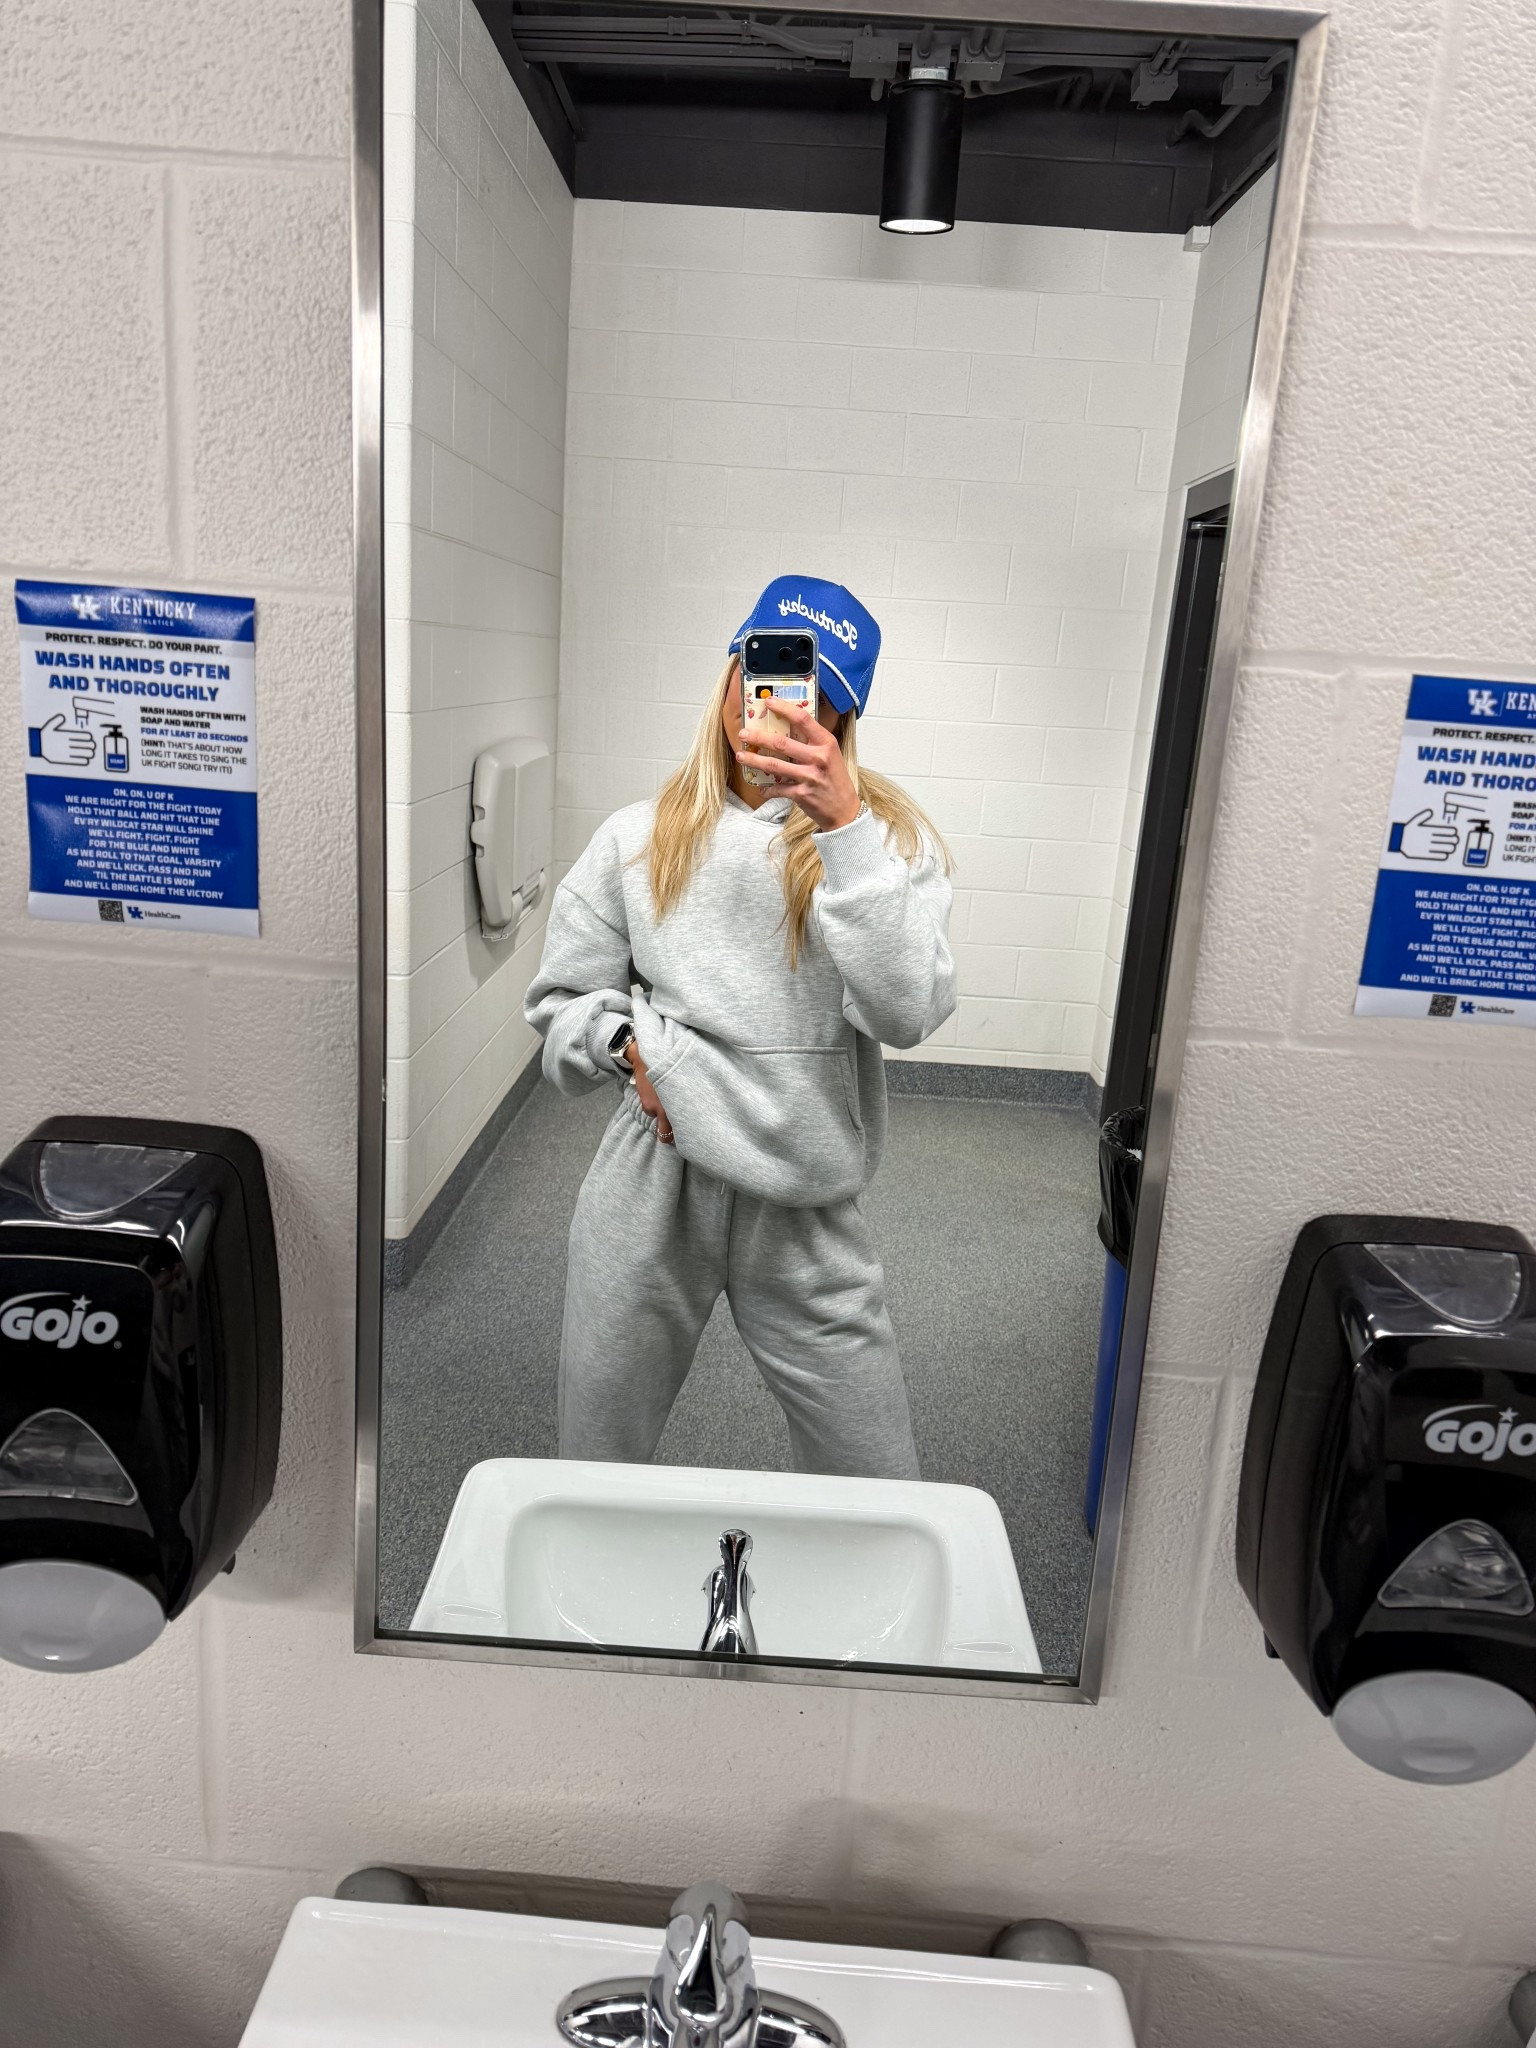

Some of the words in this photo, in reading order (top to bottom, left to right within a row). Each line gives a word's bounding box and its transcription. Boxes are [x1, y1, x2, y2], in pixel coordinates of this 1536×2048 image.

[110, 596, 195, 620] KENTUCKY
[45, 632, 95, 644] PROTECT.
[98, 636, 146, 648] RESPECT.
[149, 640, 162, 650] DO
[165, 641, 191, 652] YOUR
[194, 643, 221, 654] PART.
[35, 650, 94, 669] WASH
[99, 655, 164, 675] HANDS
[170, 660, 229, 680] OFTEN
[48, 673, 88, 691] AND
[94, 677, 218, 702] THOROUGHLY
[140, 706, 164, 715] WASH
[166, 708, 193, 717] HANDS
[195, 710, 221, 719] OFTEN
[223, 712, 245, 721] WITH
[140, 716, 162, 725] SOAP
[164, 718, 180, 726] AND
[182, 720, 210, 728] WATER
[140, 727, 157, 735] FOR
[170, 729, 194, 738] LEAST
[209, 733, 247, 742] SECONDS
[1432, 727, 1483, 739] PROTECT.
[1484, 731, 1536, 743] RESPECT.
[194, 743, 220, 752] ABOUT
[223, 745, 241, 754] HOW
[141, 749, 161, 758] LONG
[173, 752, 197, 760] TAKES
[200, 754, 209, 762] TO
[211, 755, 229, 763] SING
[231, 756, 246, 765] THE
[1417, 746, 1476, 764] WASH
[1480, 750, 1536, 769] HAND
[141, 759, 152, 767] UK
[154, 760, 175, 769] FIGHT
[203, 764, 218, 772] TRY
[1424, 769, 1466, 787] AND
[147, 791, 153, 799] U
[154, 791, 165, 800] OF
[167, 792, 173, 800] K
[65, 795, 78, 804] WE
[81, 796, 98, 805] ARE
[100, 798, 125, 807] RIGHT
[128, 800, 145, 809] FOR
[147, 801, 164, 810] THE
[166, 803, 191, 813] FIGHT
[193, 805, 221, 815] TODAY
[67, 806, 90, 815] HOLD
[93, 808, 115, 817] THAT
[117, 809, 138, 819] BALL
[140, 811, 158, 820] AND
[160, 813, 174, 822] HIT
[177, 814, 198, 823] THAT
[200, 816, 219, 825] LINE
[1510, 811, 1534, 819] SOAP
[100, 819, 138, 829] WILDCAT
[140, 822, 163, 831] STAR
[165, 824, 186, 833] WILL
[188, 826, 213, 835] SHINE
[1508, 822, 1525, 830] FOR
[88, 839, 106, 848] FOR
[108, 841, 125, 849] THE
[127, 842, 148, 851] BLUE
[150, 844, 169, 853] AND
[171, 846, 199, 855] WHITE
[174, 835, 199, 844] FIGHT
[1504, 844, 1526, 852] LONG
[66, 848, 78, 856] AS
[80, 849, 93, 858] WE
[95, 850, 117, 859] ROLL
[119, 852, 131, 860] TO
[133, 853, 155, 862] THAT
[183, 857, 221, 867] VARSITY
[76, 859, 94, 868] AND
[148, 865, 170, 874] PASS
[172, 866, 190, 875] AND
[192, 868, 211, 877] RUN
[110, 872, 127, 881] THE
[129, 874, 161, 883] BATTLE
[163, 876, 172, 884] IS
[173, 877, 194, 886] WON
[64, 879, 82, 888] AND
[111, 883, 138, 892] BRING
[140, 885, 165, 894] HOME
[167, 887, 184, 896] THE
[186, 888, 223, 899] VICTORY
[1414, 890, 1429, 898] WE
[1430, 891, 1449, 899] ARE
[1450, 892, 1477, 902] RIGHT
[1479, 895, 1498, 903] FOR
[1500, 896, 1517, 905] THE
[144, 910, 180, 919] HealthCare
[1415, 900, 1440, 909] HOLD
[1441, 902, 1464, 911] THAT
[1465, 904, 1489, 913] BALL
[1490, 906, 1509, 915] AND
[1510, 908, 1527, 916] HIT
[1447, 914, 1486, 924] WILDCAT
[1488, 917, 1512, 926] STAR
[1431, 934, 1450, 942] FOR
[1452, 936, 1470, 944] THE
[1471, 937, 1494, 946] BLUE
[1495, 939, 1515, 947] AND
[1437, 945, 1461, 954] ROLL
[1462, 947, 1475, 955] TO
[1476, 948, 1500, 957] THAT
[1415, 954, 1435, 962] AND
[1490, 960, 1514, 969] PASS
[1449, 967, 1467, 975] THE
[1468, 969, 1502, 978] BATTLE
[1399, 974, 1419, 982] AND
[1449, 978, 1477, 987] BRING
[1478, 980, 1505, 989] HOME
[1507, 982, 1525, 991] THE
